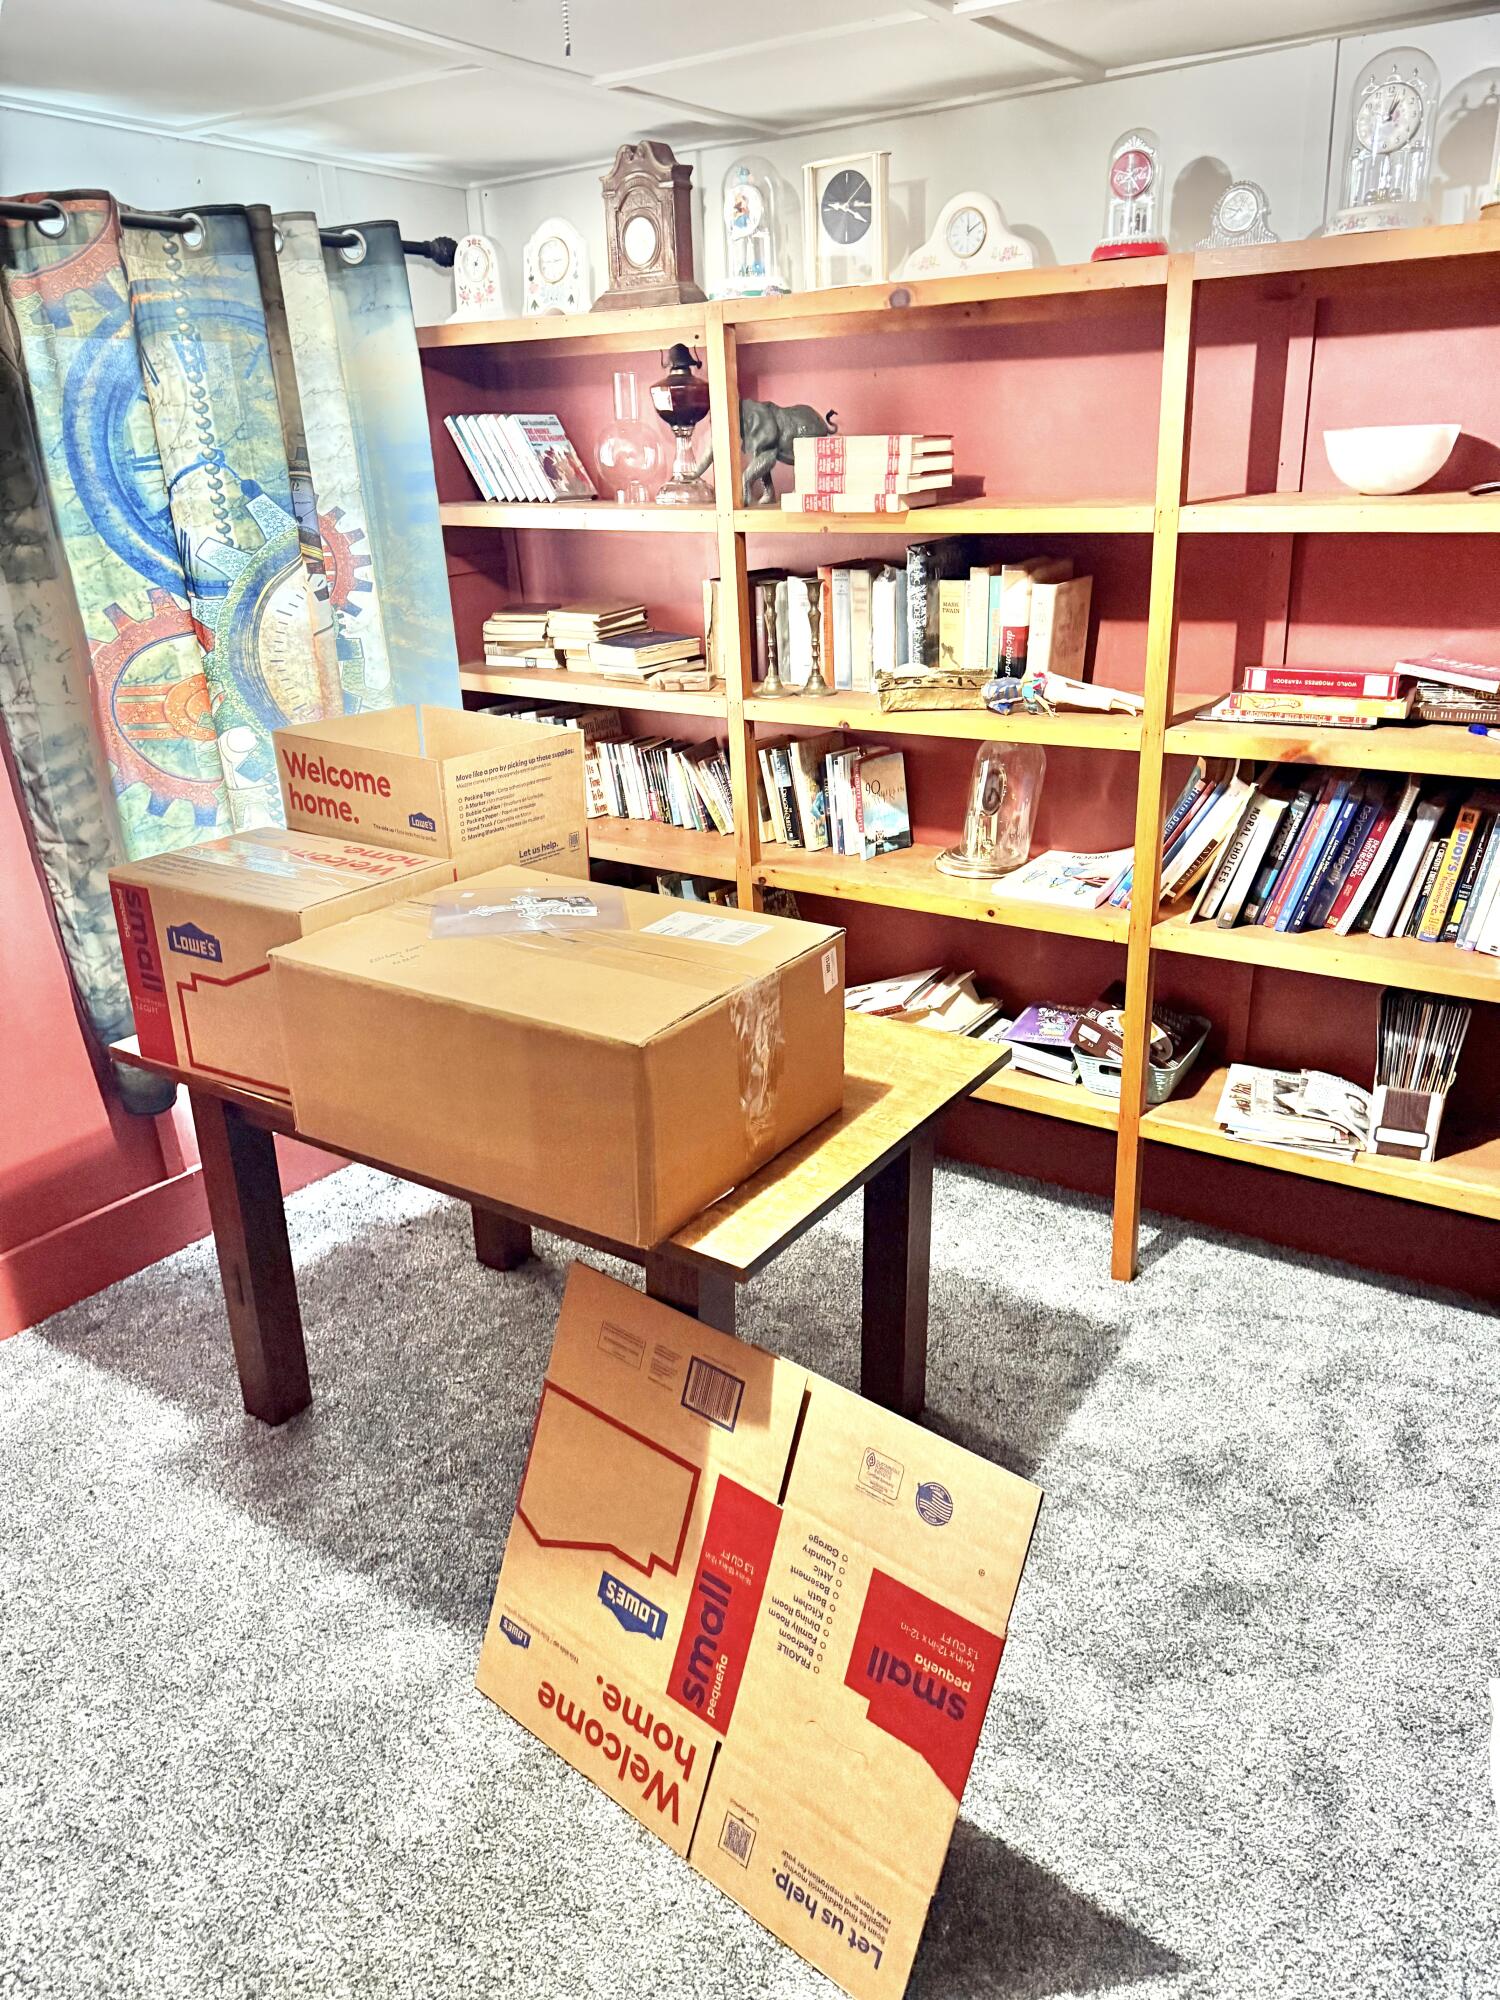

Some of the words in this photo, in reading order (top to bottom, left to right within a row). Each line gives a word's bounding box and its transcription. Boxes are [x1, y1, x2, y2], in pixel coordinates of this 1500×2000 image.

[282, 749, 391, 797] Welcome
[455, 773, 471, 781] Move
[472, 769, 483, 777] like
[498, 764, 506, 772] by
[507, 759, 527, 770] picking
[288, 783, 359, 824] home.
[1177, 786, 1201, 815] HEALTHY
[411, 816, 434, 830] LOWE'S
[480, 820, 492, 828] Truck
[1240, 807, 1260, 838] MORAL
[1346, 804, 1373, 847] beyond
[519, 848, 530, 858] Let
[531, 846, 540, 854] us
[541, 839, 558, 852] help.
[1217, 841, 1243, 883] CHOICES
[1446, 829, 1469, 872] IDIOT'S
[1325, 844, 1354, 886] integrity
[123, 886, 164, 996] small
[172, 929, 216, 958] LOWE'S
[801, 1542, 836, 1571] Laundry
[807, 1531, 839, 1558] Garage
[789, 1564, 830, 1595] Basement
[812, 1564, 833, 1583] Attic
[606, 1579, 660, 1633] LOWE'S
[770, 1595, 793, 1616] Room
[792, 1594, 824, 1620] Kitchen
[806, 1589, 827, 1607] Bath
[502, 1618, 528, 1644] LOWE'S
[767, 1607, 790, 1627] Room
[794, 1608, 820, 1632] Dining
[899, 1620, 920, 1640] 12-in
[678, 1569, 732, 1710] small
[778, 1627, 814, 1657] Bedroom
[790, 1620, 817, 1645] Family
[926, 1637, 948, 1657] 12-in
[940, 1631, 951, 1644] FT
[951, 1638, 966, 1653] CU
[776, 1641, 811, 1669] FRAGILE
[705, 1652, 729, 1719] pequeña
[866, 1645, 967, 1724] small
[913, 1652, 971, 1693] pequeña
[596, 1675, 696, 1781] home.
[537, 1681, 679, 1825] Welcome
[782, 1859, 808, 1884] moving
[796, 1860, 807, 1873] for
[771, 1866, 818, 1920] help.
[806, 1867, 843, 1902] inspiration
[807, 1880, 843, 1912] additional
[843, 1896, 858, 1912] and
[843, 1907, 858, 1924] find
[819, 1906, 845, 1936] us
[858, 1906, 889, 1936] supplies
[845, 1927, 882, 1970] Let
